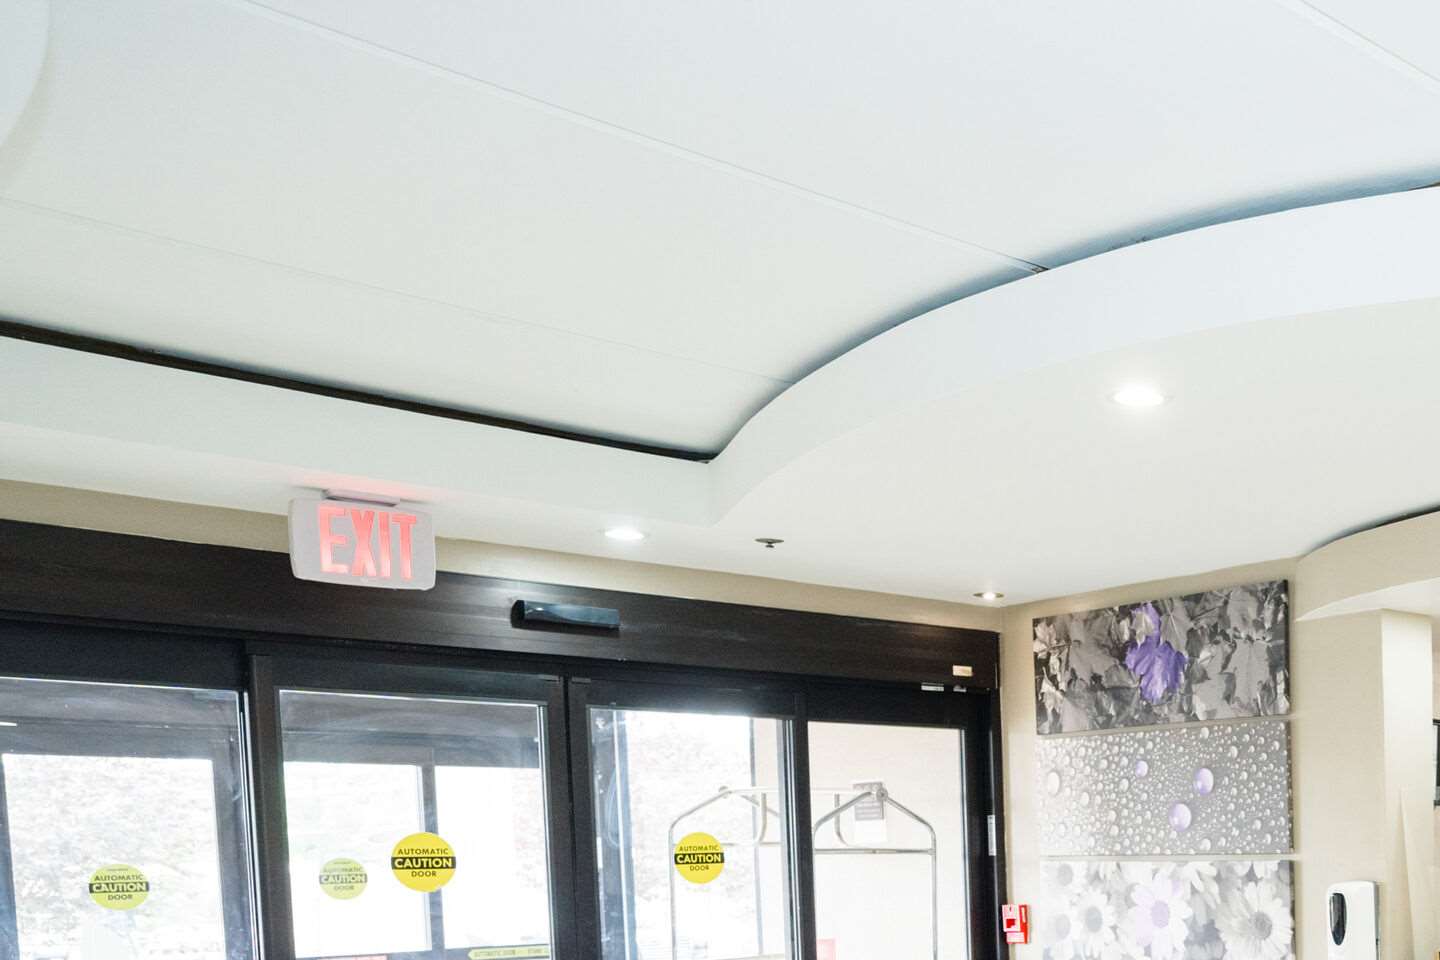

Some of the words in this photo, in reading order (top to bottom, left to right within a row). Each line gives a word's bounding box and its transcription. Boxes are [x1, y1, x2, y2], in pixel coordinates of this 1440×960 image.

[318, 504, 417, 582] EXIT
[397, 848, 449, 856] AUTOMATIC
[394, 857, 453, 869] CAUTION
[676, 853, 721, 864] CAUTION
[689, 864, 710, 872] DOOR
[93, 873, 144, 882] AUTOMATIC
[410, 870, 437, 878] DOOR
[92, 882, 147, 893] CAUTION
[107, 893, 134, 901] DOOR
